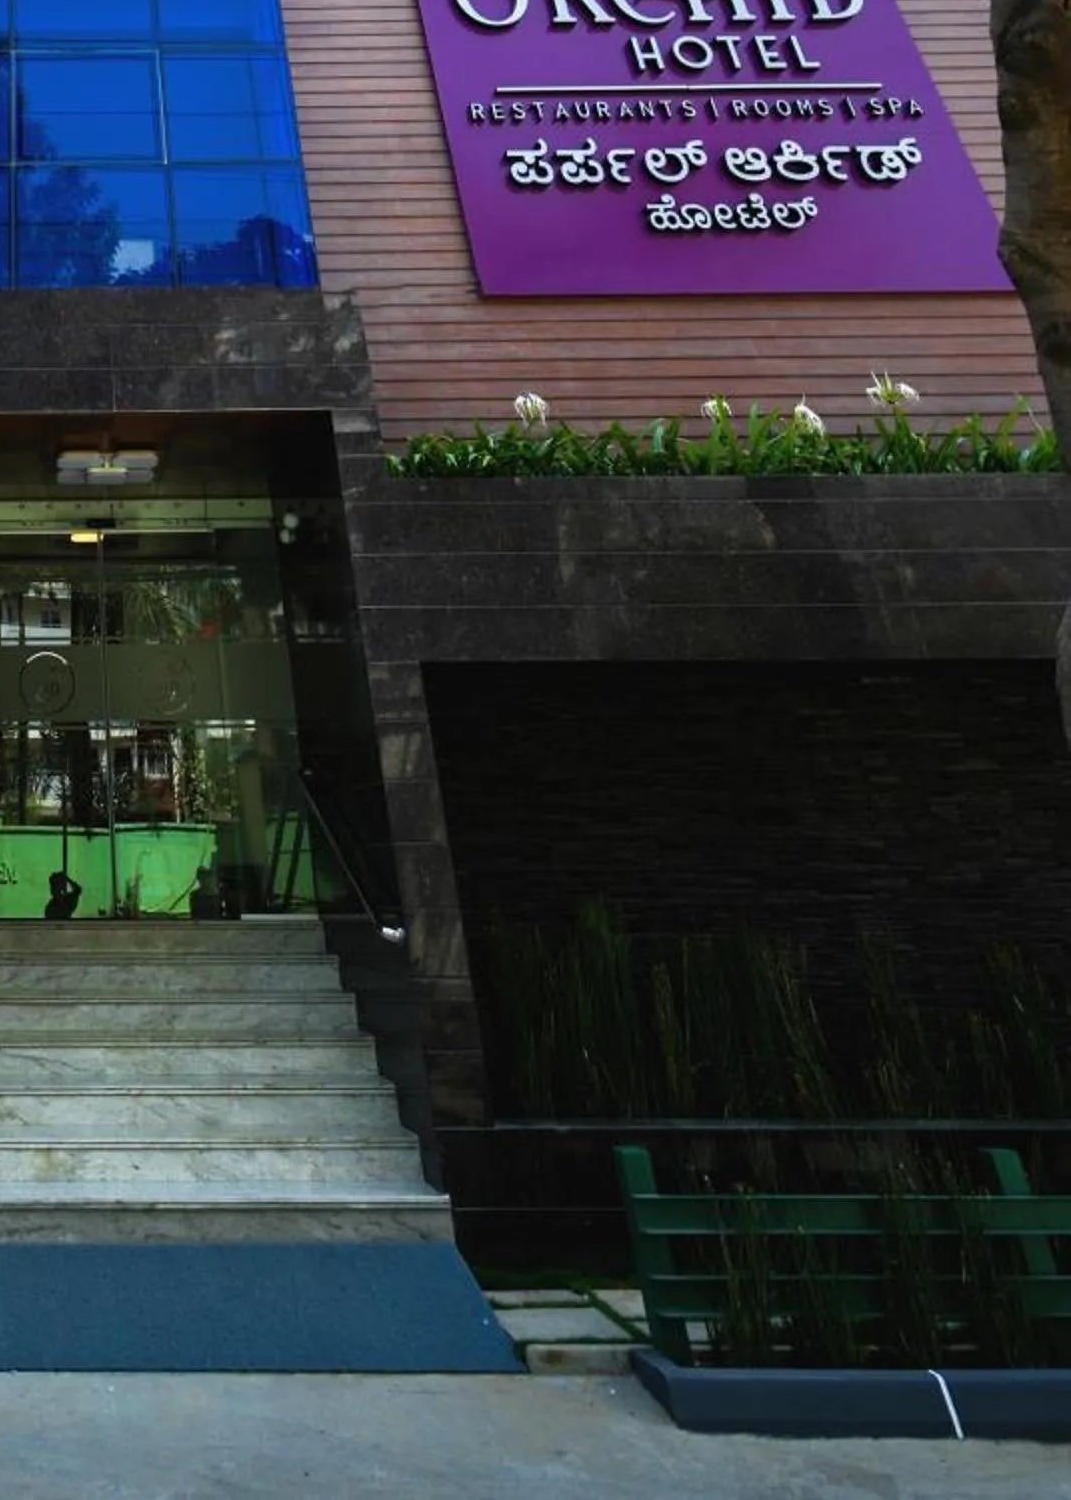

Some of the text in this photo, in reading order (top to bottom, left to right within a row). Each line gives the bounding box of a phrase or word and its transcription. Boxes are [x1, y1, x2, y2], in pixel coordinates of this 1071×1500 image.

[630, 34, 822, 70] HOTEL
[470, 96, 925, 120] RESTAURANTS ROOMS SPA
[506, 136, 923, 185] ಪರ್ಪಲ್ ಆರ್ಕಿಡ್
[646, 192, 819, 231] ಹೋಟೆಲ್
